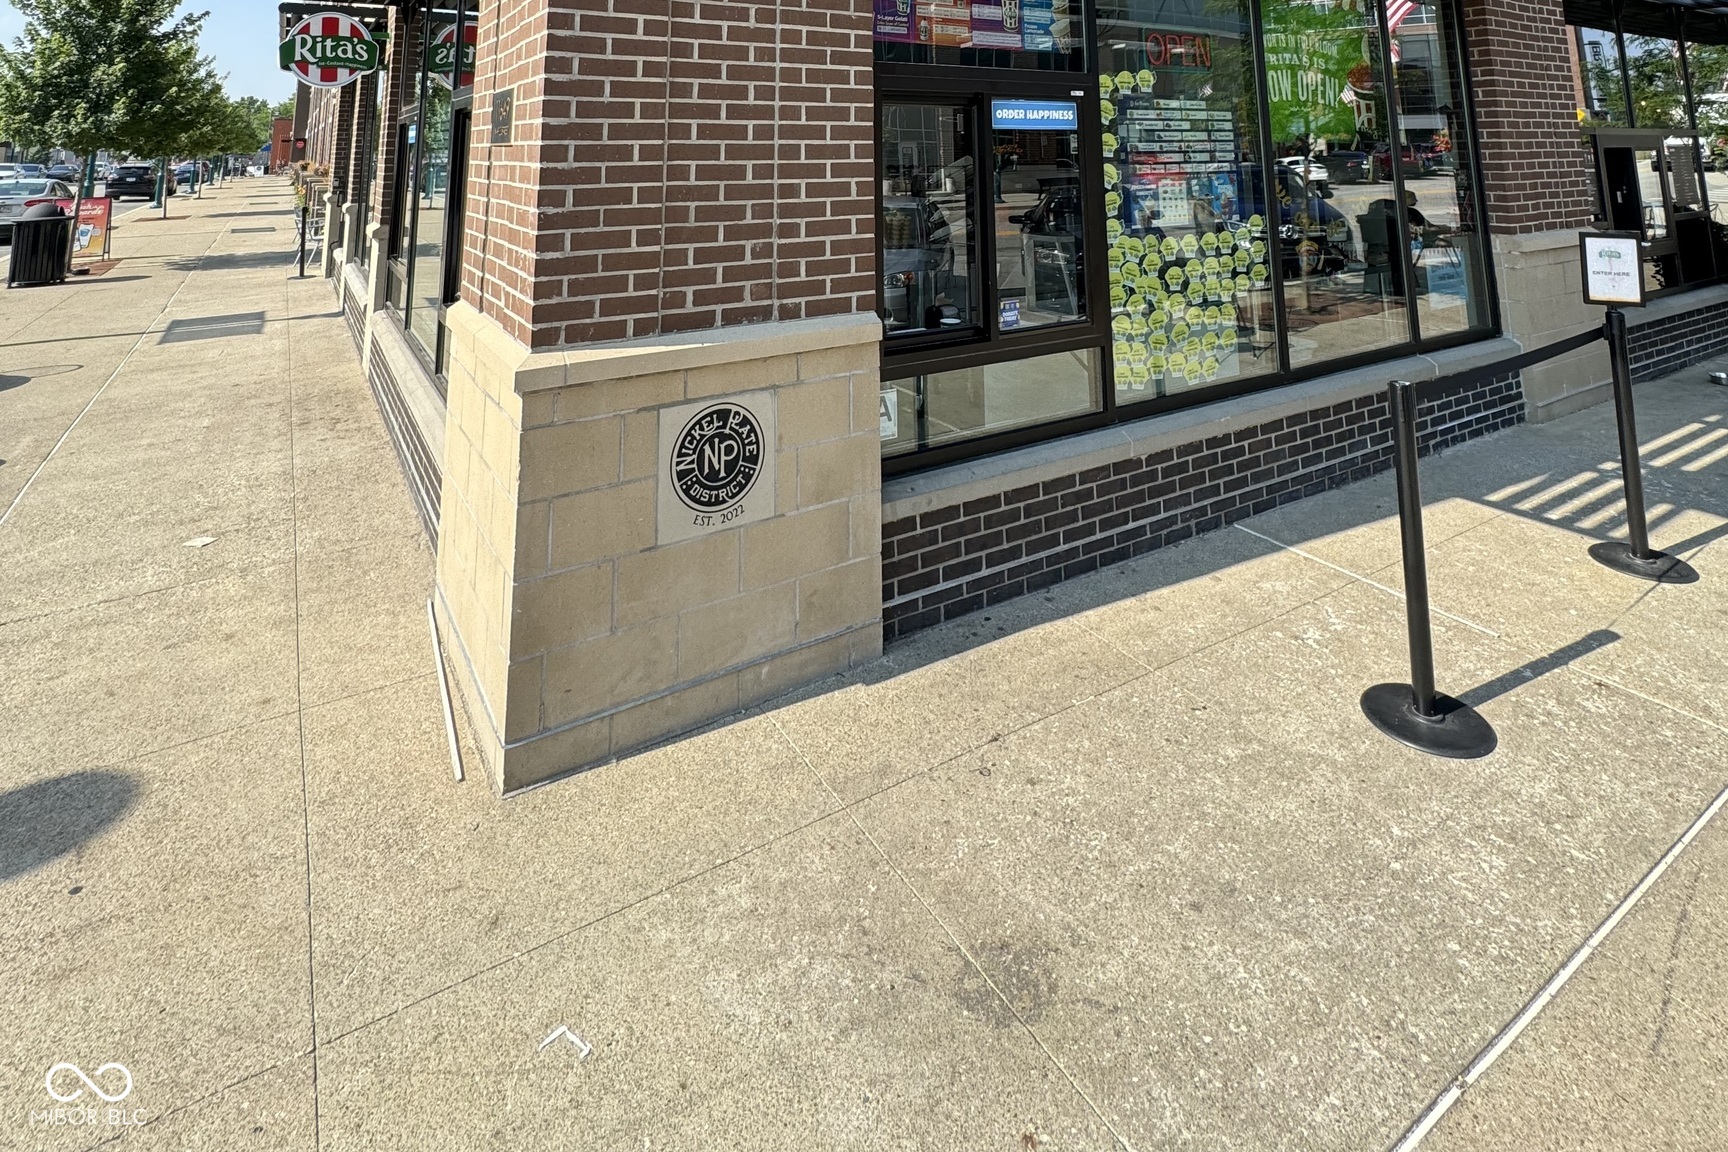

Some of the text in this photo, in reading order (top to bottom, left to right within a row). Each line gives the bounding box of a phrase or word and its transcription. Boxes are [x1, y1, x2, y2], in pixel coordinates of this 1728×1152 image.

[294, 34, 369, 64] Rita's
[1146, 32, 1211, 67] OPEN
[996, 108, 1074, 120] ORDER HAPPINESS
[675, 408, 757, 472] NICKEL PLATE
[703, 437, 738, 479] NP
[689, 473, 747, 503] DISTRICT
[693, 504, 746, 527] EST. 2022
